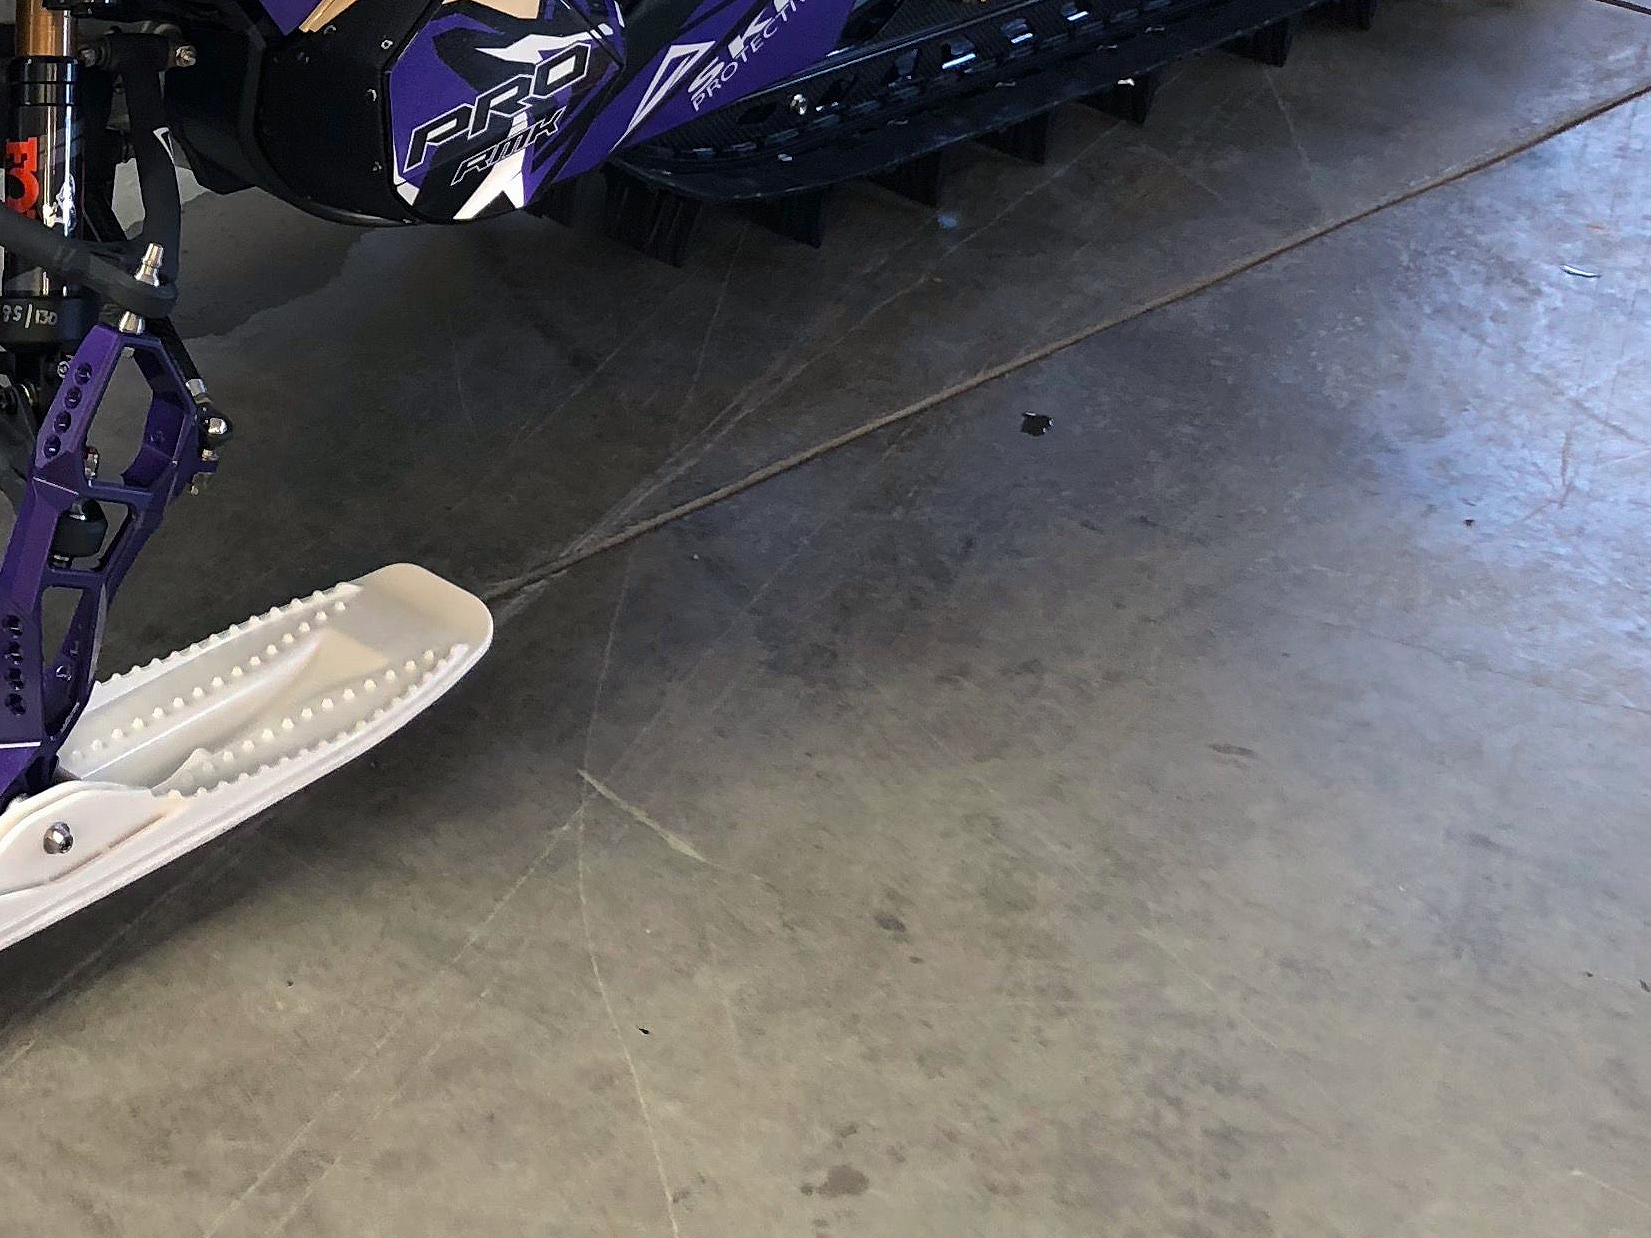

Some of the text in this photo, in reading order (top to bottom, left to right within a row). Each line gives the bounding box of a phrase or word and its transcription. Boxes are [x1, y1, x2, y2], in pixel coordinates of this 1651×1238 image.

[402, 41, 592, 175] PRO
[450, 105, 568, 187] RMK
[5, 135, 40, 220] FO
